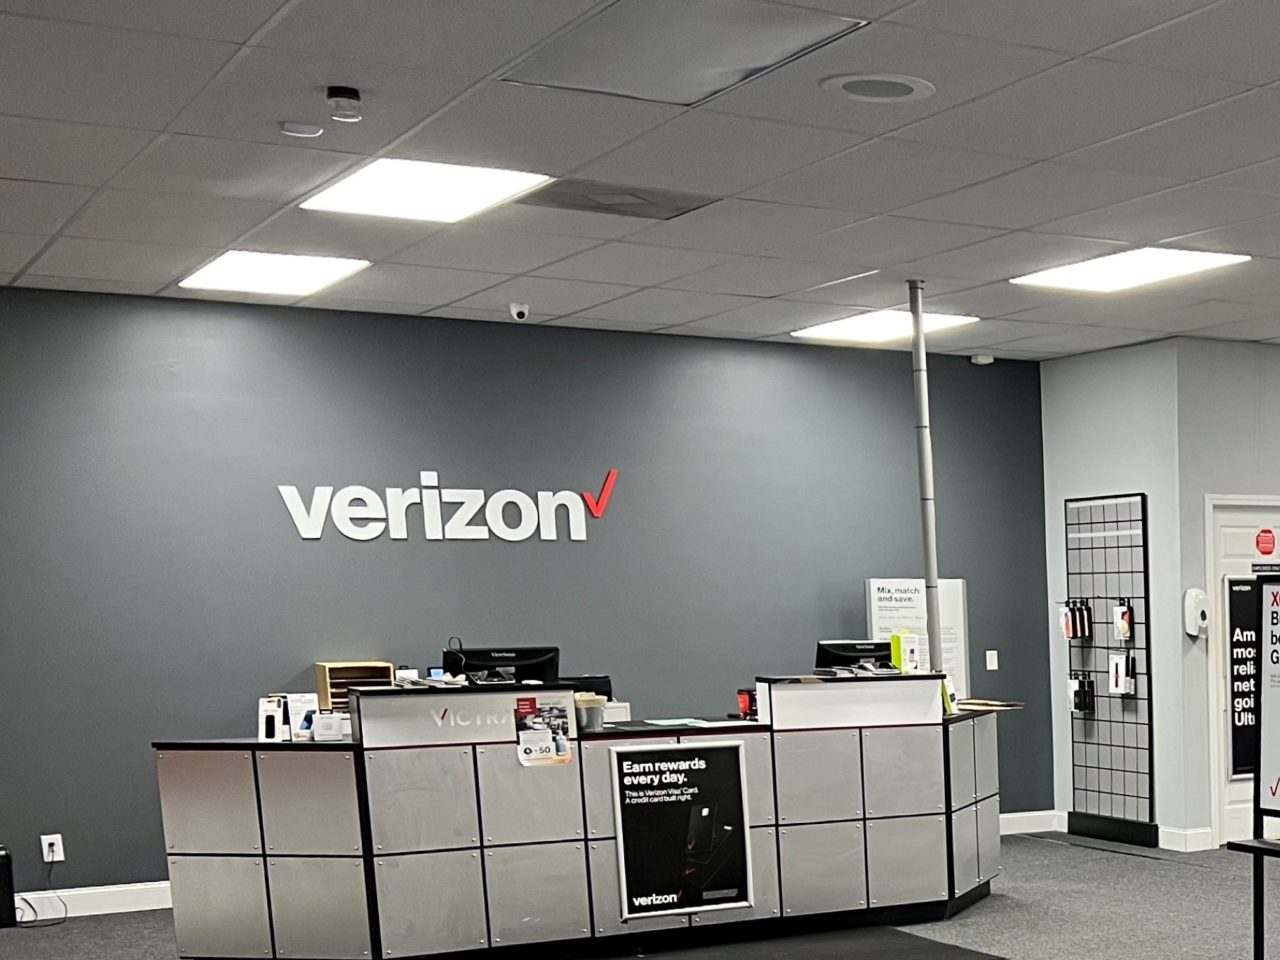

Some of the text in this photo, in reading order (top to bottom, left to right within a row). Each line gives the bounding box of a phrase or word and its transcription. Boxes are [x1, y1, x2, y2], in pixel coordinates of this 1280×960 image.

[277, 470, 588, 542] verizon
[622, 757, 707, 773] Earn rewards
[623, 771, 688, 786] every day.
[632, 892, 678, 906] verizon
